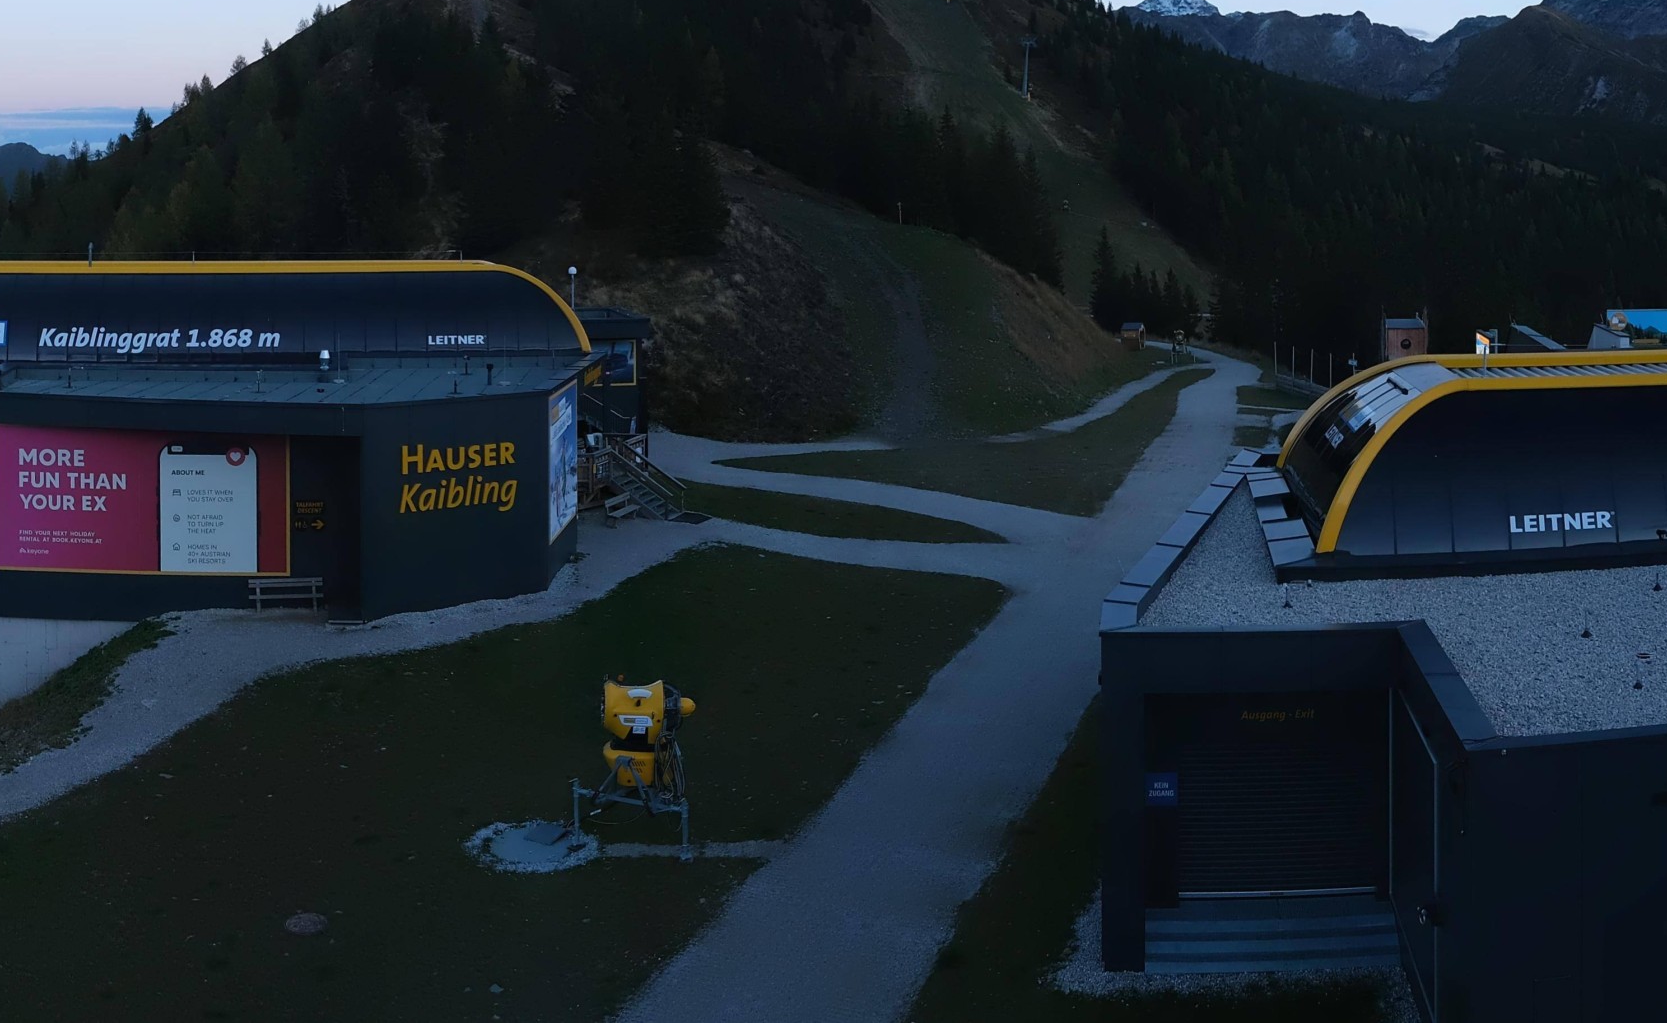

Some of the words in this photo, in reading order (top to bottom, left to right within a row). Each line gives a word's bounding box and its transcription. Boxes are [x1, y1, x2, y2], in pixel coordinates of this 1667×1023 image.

[38, 327, 181, 354] Kaiblinggrat
[185, 328, 252, 348] 1.868
[258, 333, 280, 348] m
[428, 335, 485, 345] LEITNER
[18, 448, 85, 467] MORE
[401, 442, 516, 475] HAUSER
[18, 471, 60, 489] FUN
[67, 473, 127, 490] THAN
[19, 494, 76, 511] YOUR
[81, 495, 107, 512] EX
[400, 475, 518, 514] Kaibling
[1509, 511, 1613, 533] LEITNER
[1240, 710, 1286, 722] Ausgang
[1295, 708, 1315, 719] Exit
